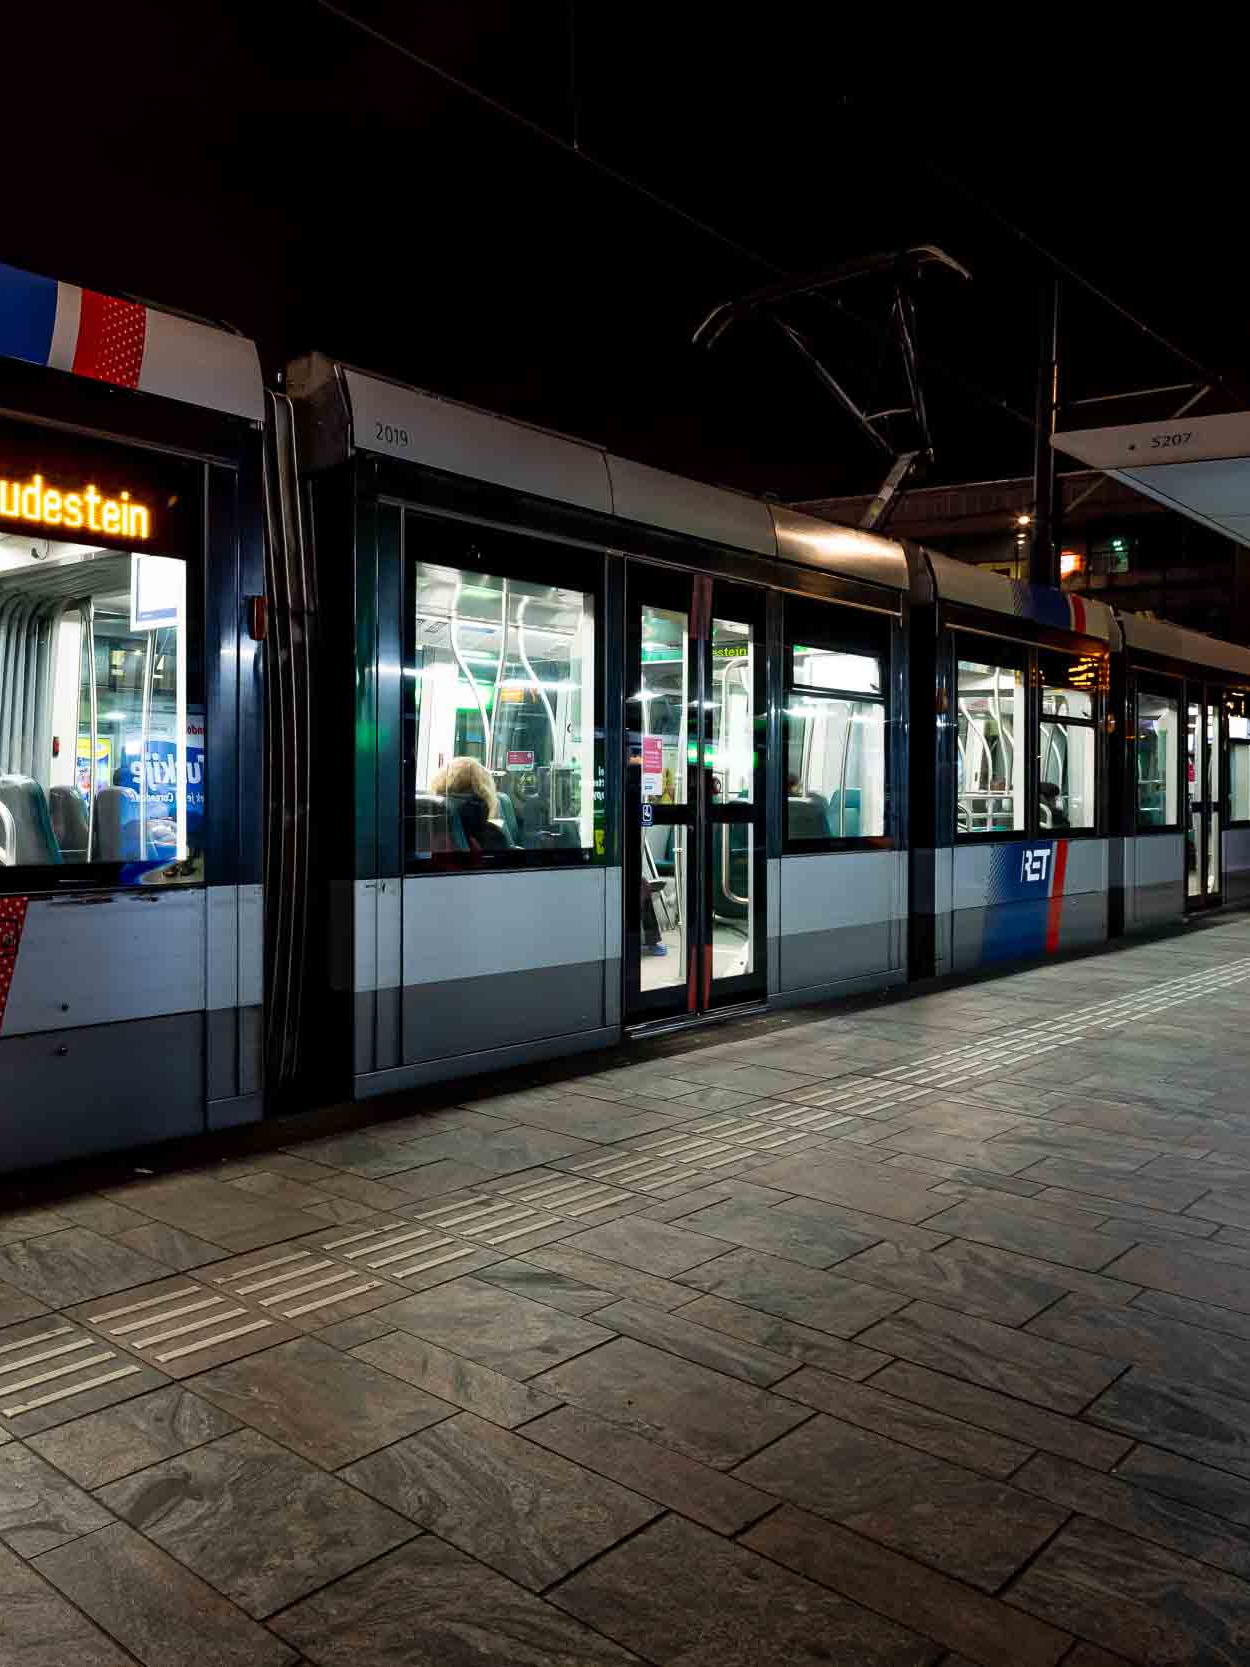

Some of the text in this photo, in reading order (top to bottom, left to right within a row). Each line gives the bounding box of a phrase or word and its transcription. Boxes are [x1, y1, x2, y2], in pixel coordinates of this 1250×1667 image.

[375, 421, 408, 447] 2019
[1150, 431, 1191, 448] S207
[1025, 848, 1051, 882] RET
